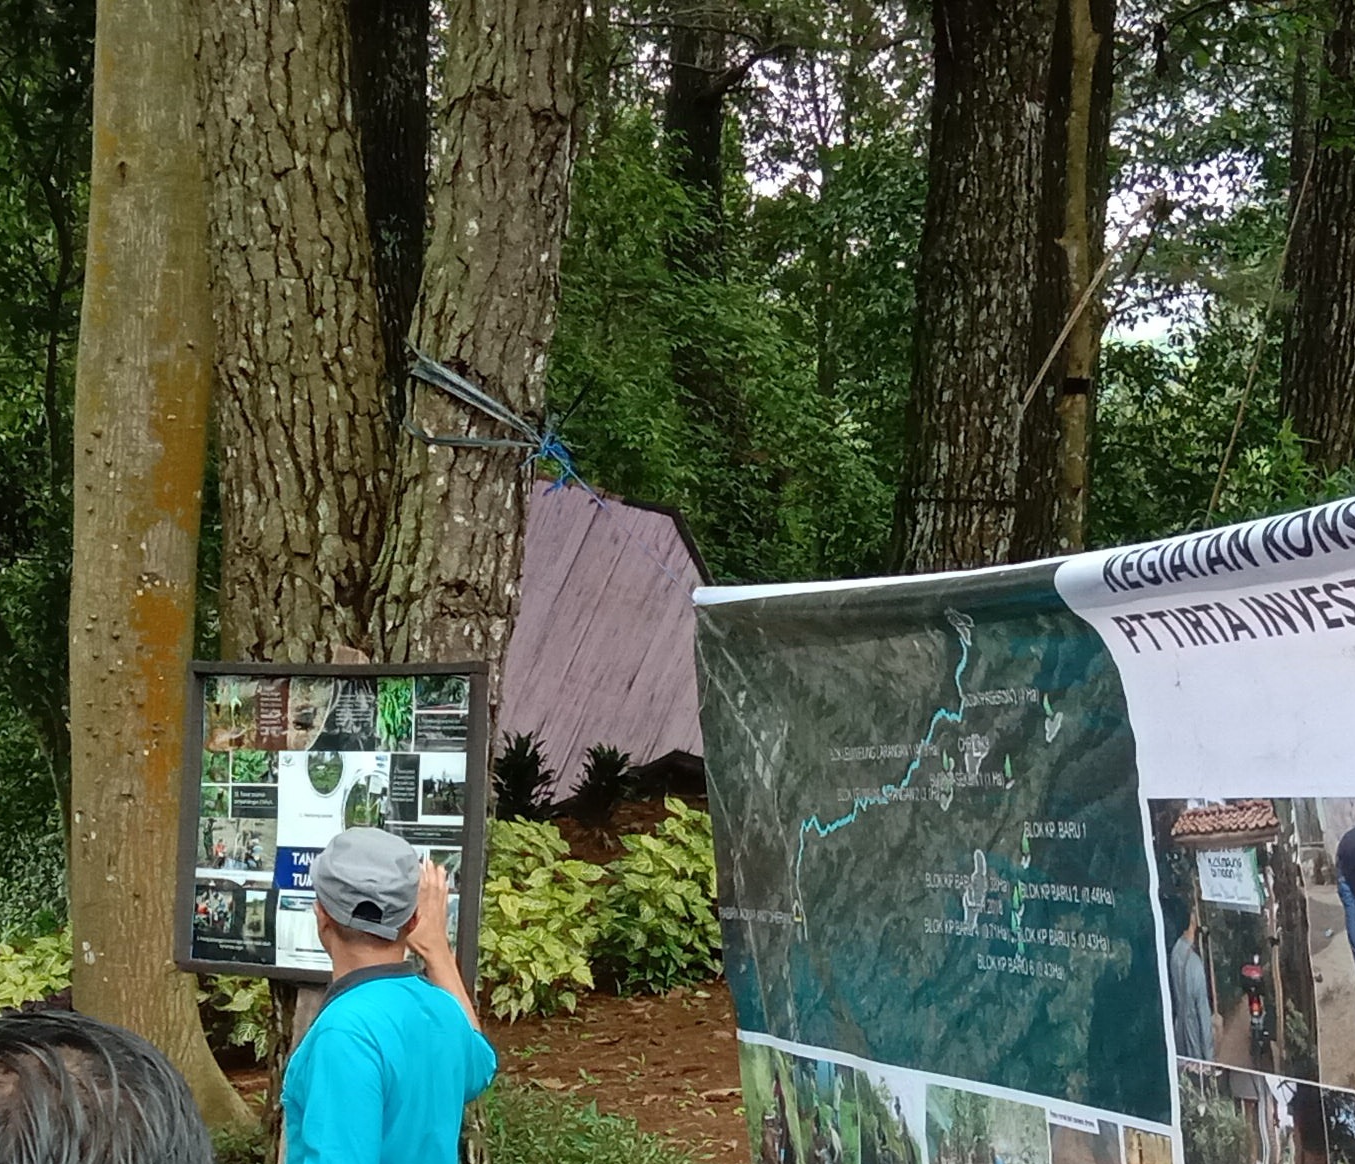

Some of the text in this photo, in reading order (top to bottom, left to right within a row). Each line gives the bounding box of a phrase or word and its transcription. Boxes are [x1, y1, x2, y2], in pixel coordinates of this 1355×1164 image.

[1103, 524, 1256, 593] KEGIATAN
[1111, 612, 1162, 654] PT
[1146, 601, 1257, 649] TIRTA
